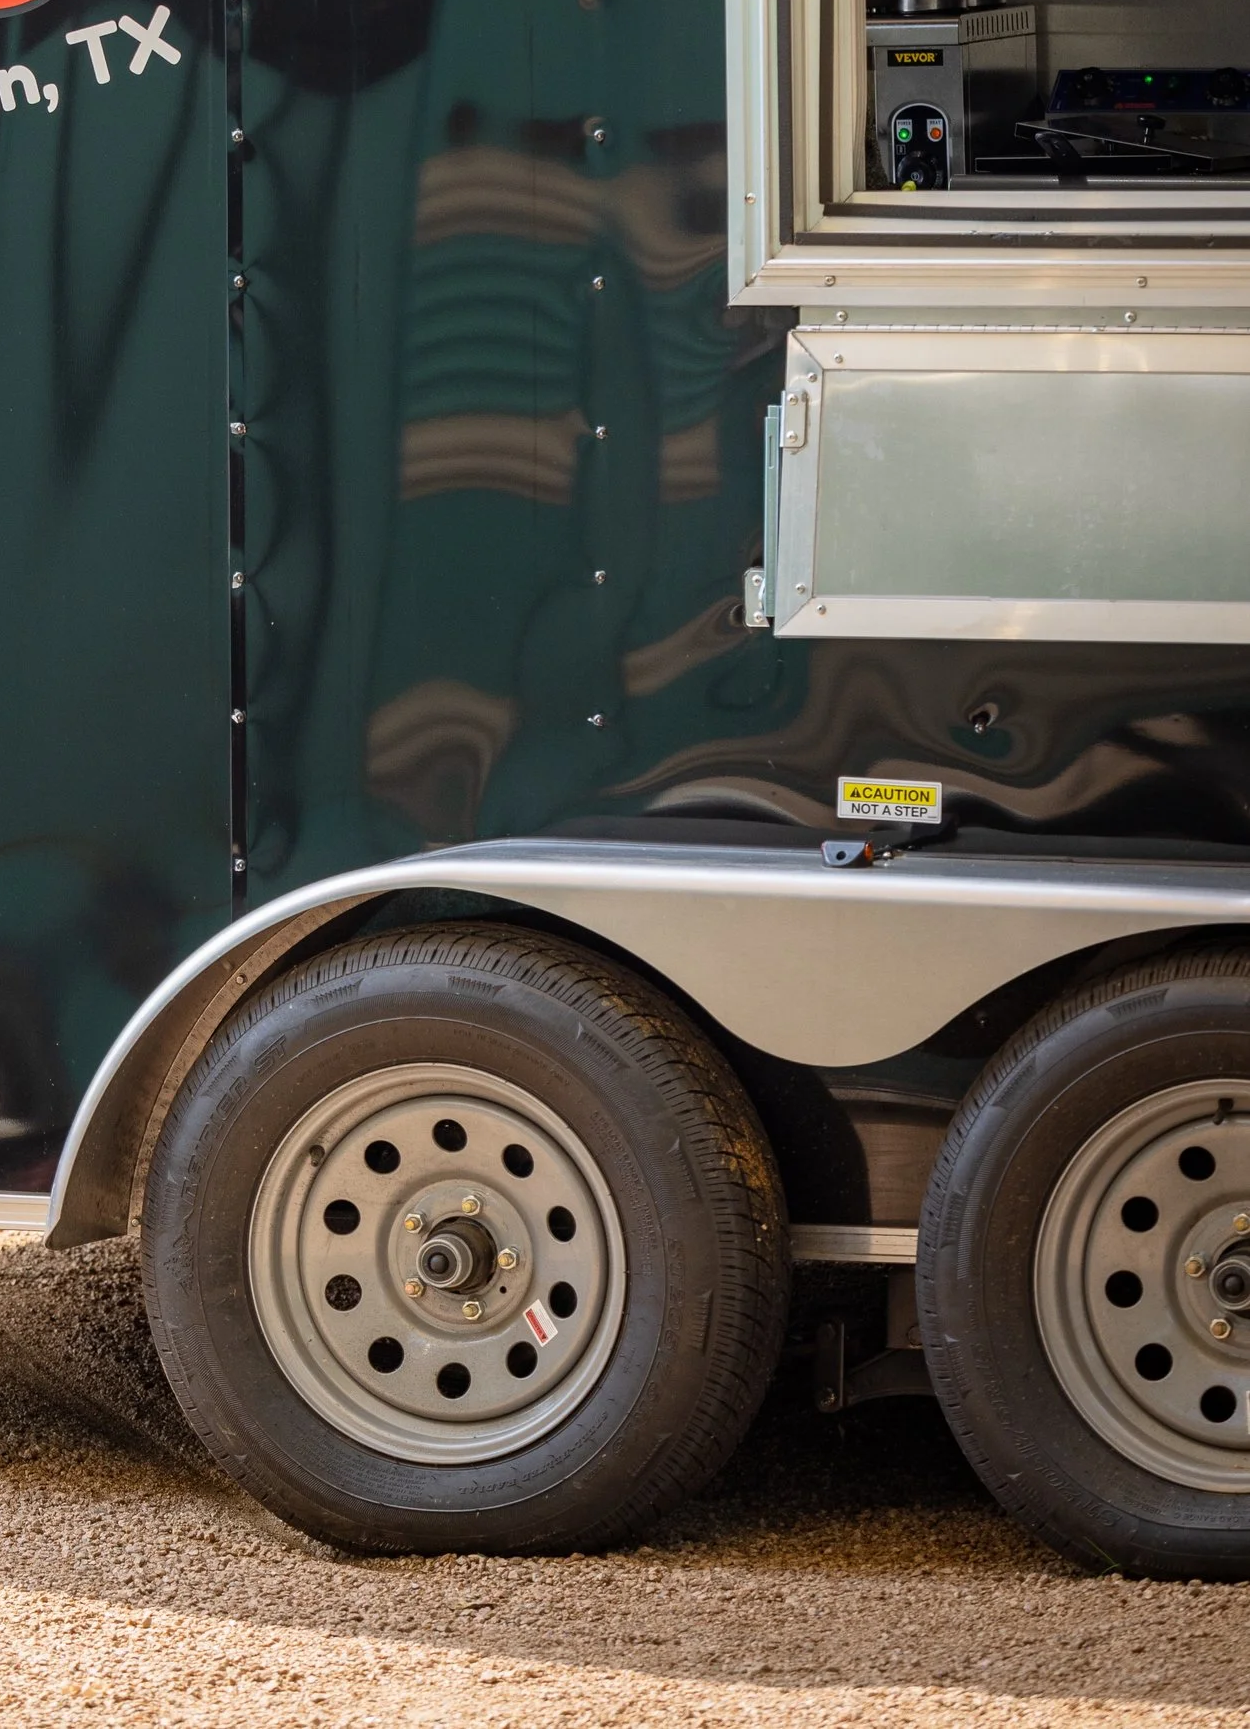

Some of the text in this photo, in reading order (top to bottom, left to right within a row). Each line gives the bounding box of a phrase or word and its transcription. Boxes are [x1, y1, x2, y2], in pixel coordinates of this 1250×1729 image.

[65, 5, 182, 86] TX
[894, 52, 935, 63] VEVOR
[862, 787, 930, 802] CAUTION
[851, 803, 879, 815] NOT
[882, 805, 891, 816] A
[894, 806, 928, 817] STEP
[248, 1033, 293, 1077] ST
